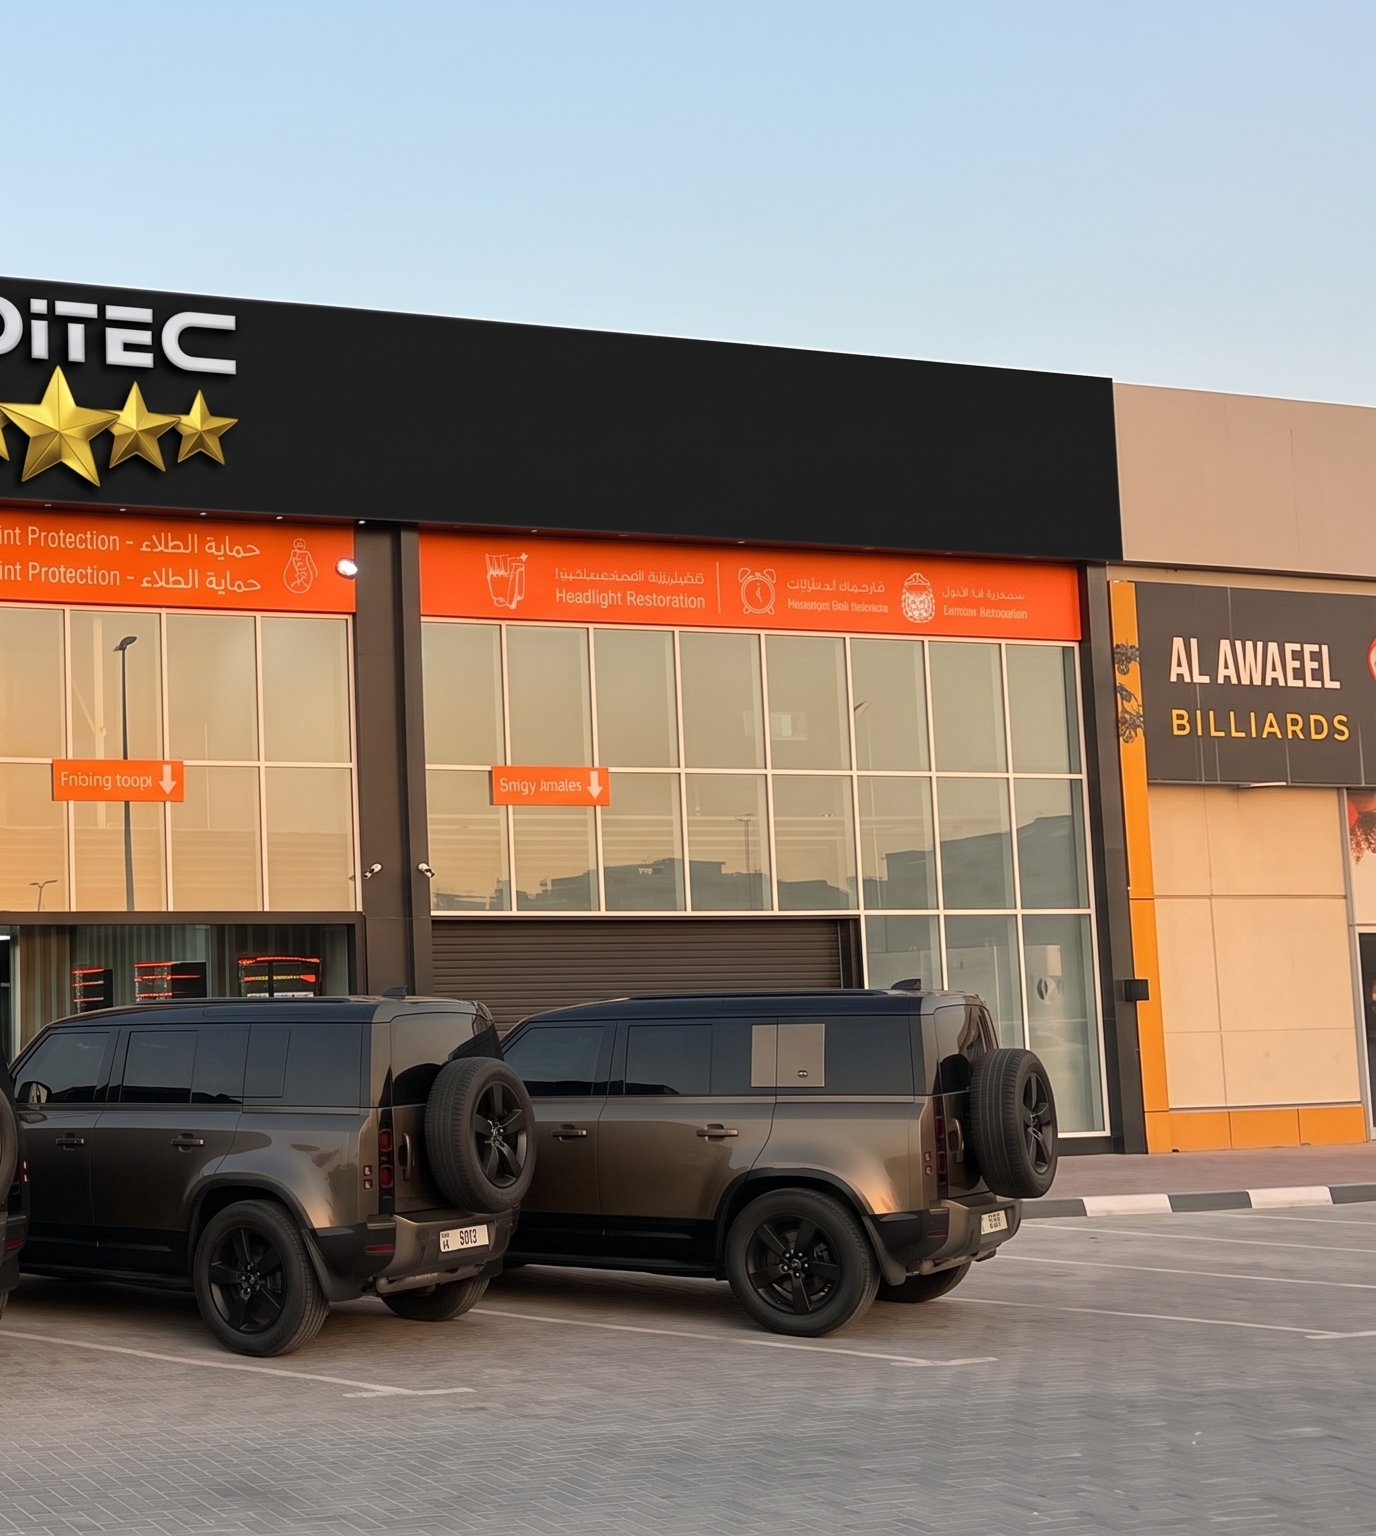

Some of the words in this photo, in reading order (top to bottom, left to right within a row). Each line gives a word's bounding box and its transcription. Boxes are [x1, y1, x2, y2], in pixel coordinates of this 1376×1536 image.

[27, 525, 120, 551] Protection
[140, 531, 198, 554] الطلاء
[204, 535, 261, 560] حماية
[28, 561, 121, 586] Protection
[140, 567, 199, 589] الطلاء
[205, 570, 262, 595] حماية
[555, 587, 623, 609] Headlight
[626, 590, 706, 609] Restoration
[1169, 636, 1211, 684] AL
[1216, 638, 1341, 690] AWAEEL
[1171, 708, 1351, 742] BILLIARDS
